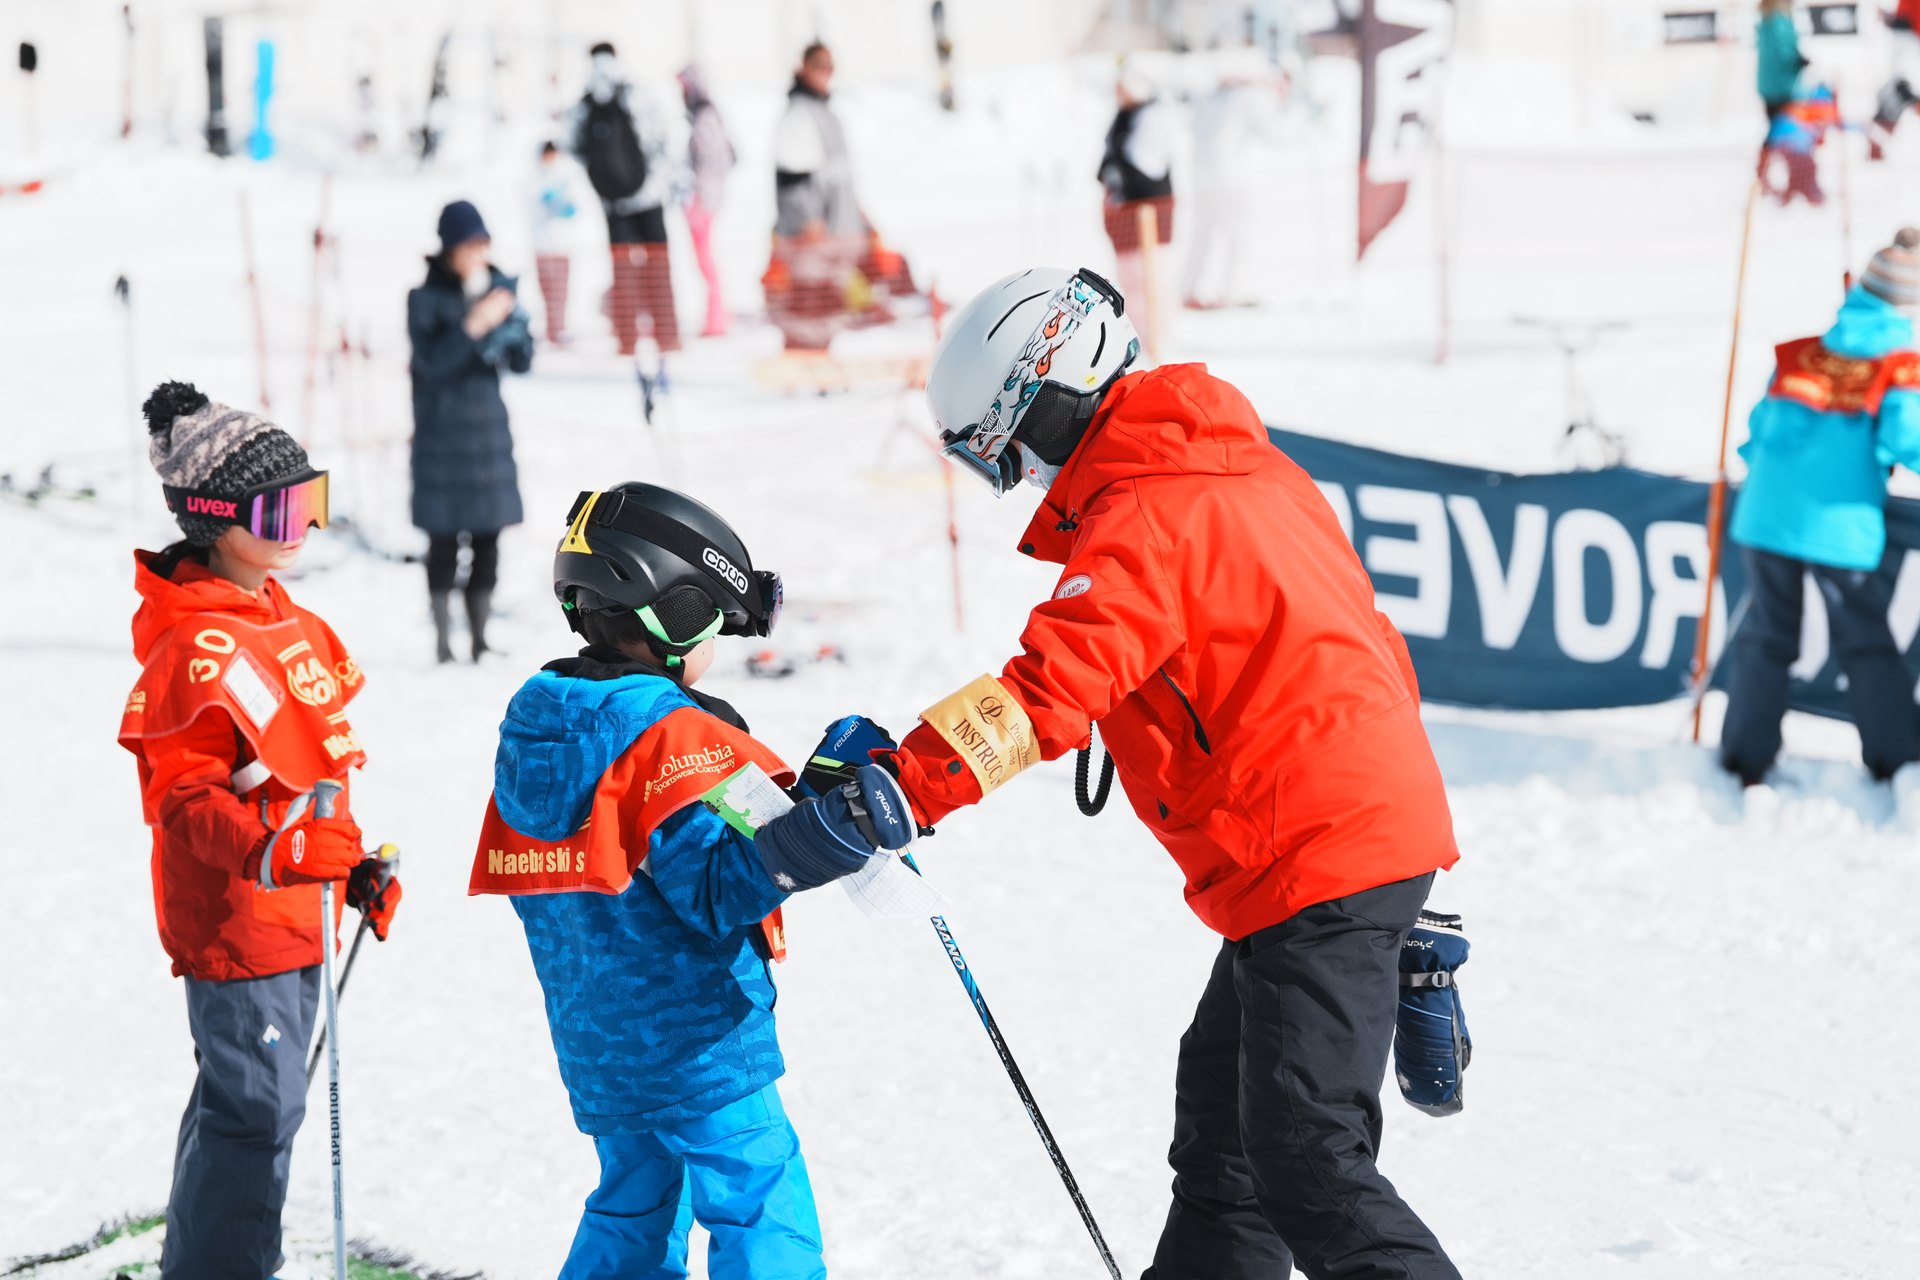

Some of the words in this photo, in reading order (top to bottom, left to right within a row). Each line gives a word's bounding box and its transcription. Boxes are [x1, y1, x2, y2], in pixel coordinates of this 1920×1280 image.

[187, 496, 237, 519] uvex
[189, 629, 236, 684] 30
[834, 721, 860, 752] reusch
[653, 767, 697, 795] Sportswear
[695, 757, 735, 774] Company
[875, 789, 898, 825] phenix
[546, 847, 570, 873] ski
[931, 917, 966, 970] NANO
[1403, 940, 1434, 950] pheni
[329, 1081, 341, 1166] EXPEDITION
